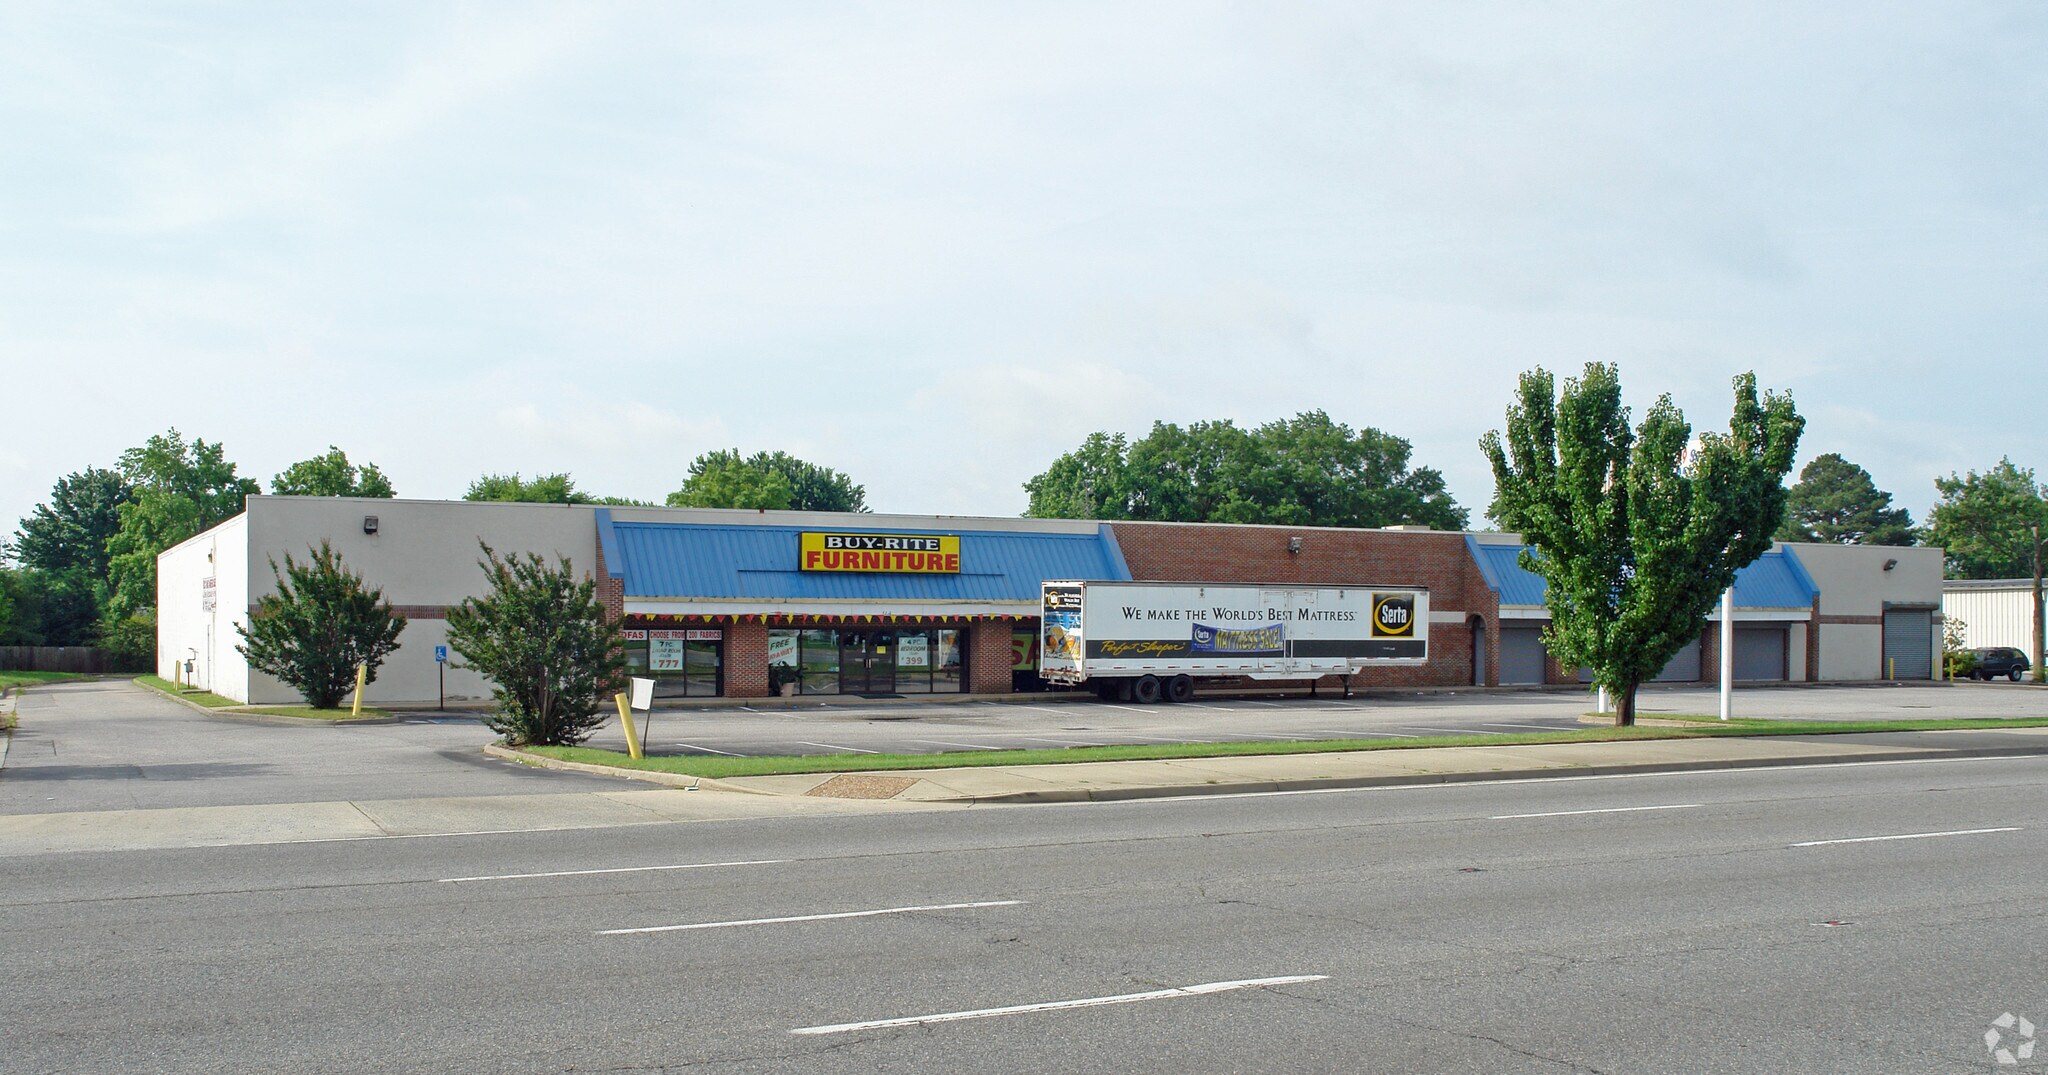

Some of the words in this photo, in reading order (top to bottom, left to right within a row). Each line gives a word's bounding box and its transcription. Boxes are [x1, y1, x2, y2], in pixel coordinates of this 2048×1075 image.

[827, 536, 939, 550] BUY-RITE
[806, 551, 959, 571] FURNITURE
[1121, 606, 1142, 620] WE
[1147, 609, 1180, 620] MAKE
[1186, 609, 1207, 620] THE
[1213, 607, 1263, 620] WORLD'S
[1268, 608, 1293, 621] BEST
[1382, 604, 1407, 624] Serta
[650, 631, 670, 639] CHOOSE
[700, 631, 721, 639] FABRICS
[1215, 629, 1258, 650] MATTRESS
[770, 637, 791, 651] FREE
[1101, 640, 1140, 656] Perfect
